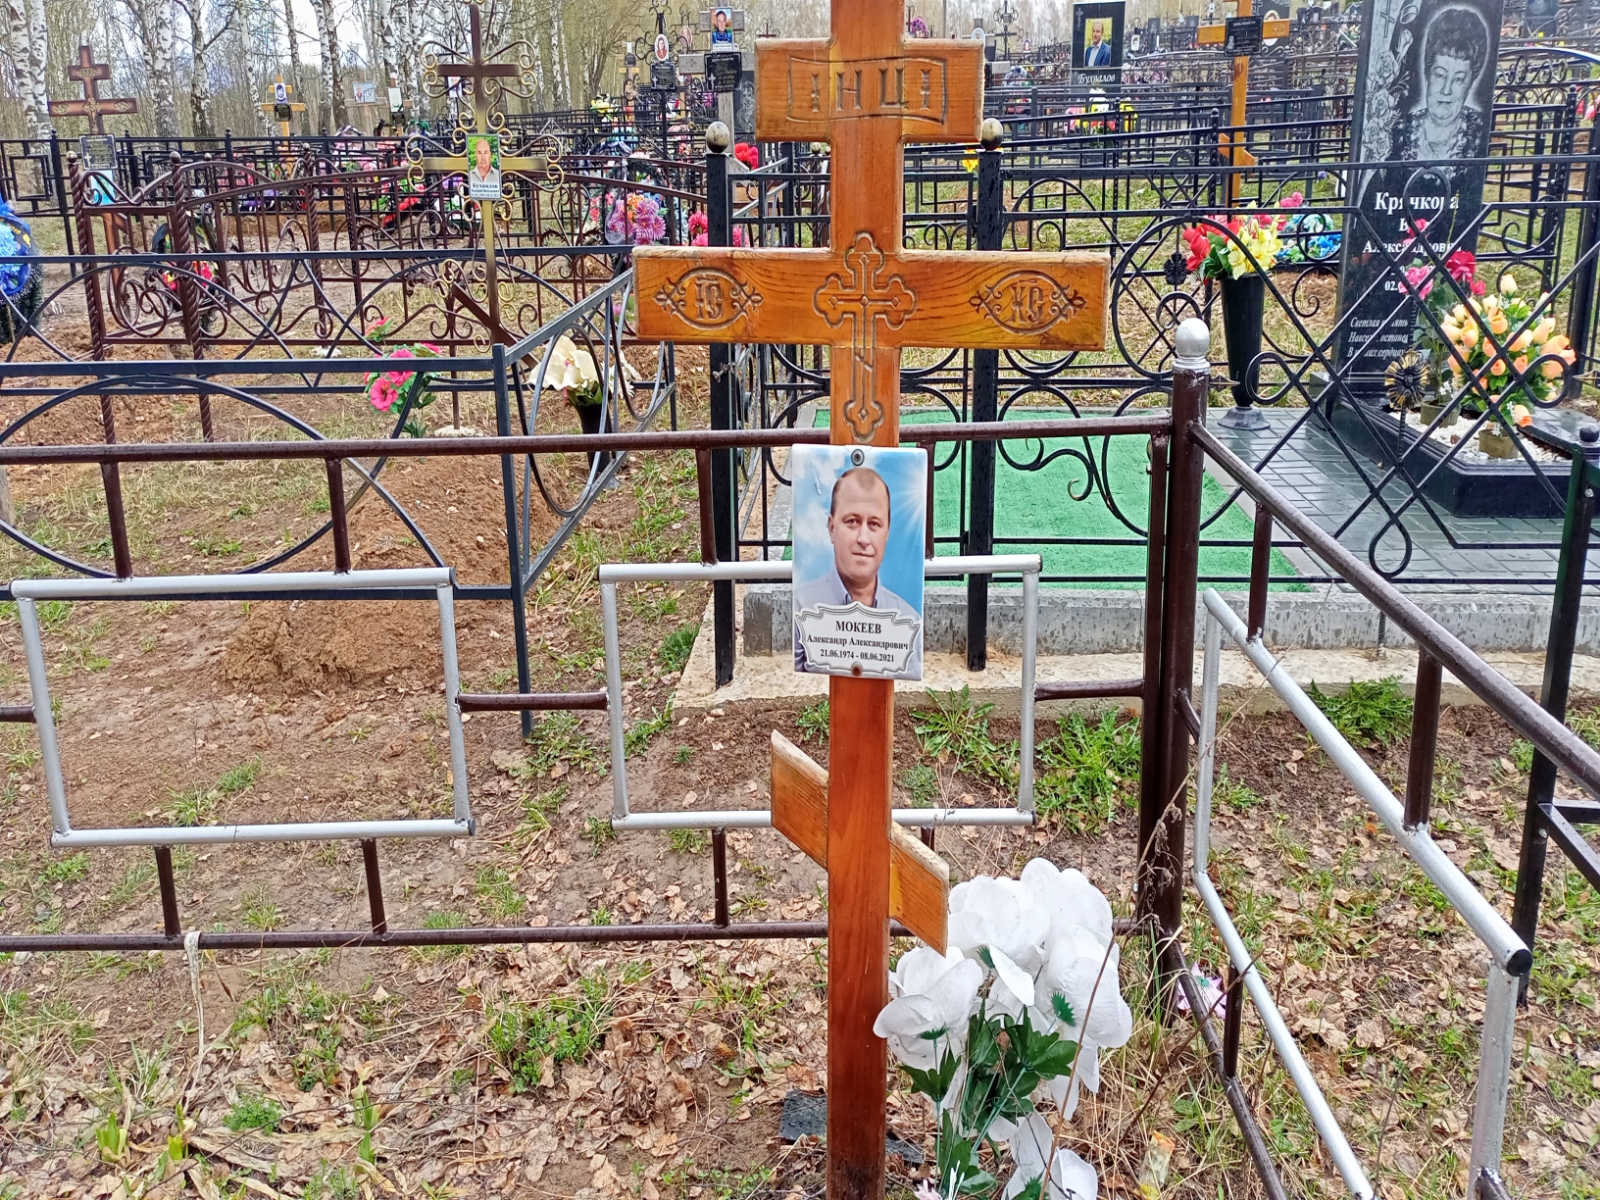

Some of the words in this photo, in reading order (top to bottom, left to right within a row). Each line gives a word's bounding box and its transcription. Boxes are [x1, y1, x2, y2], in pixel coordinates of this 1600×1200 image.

[1374, 191, 1460, 215] Крчкоа
[835, 620, 882, 634] МОКЕЕВ
[807, 634, 848, 647] Александр
[849, 638, 909, 650] Александрович
[820, 649, 855, 659] 21.06.1974
[860, 653, 895, 663] 08.06.2021
